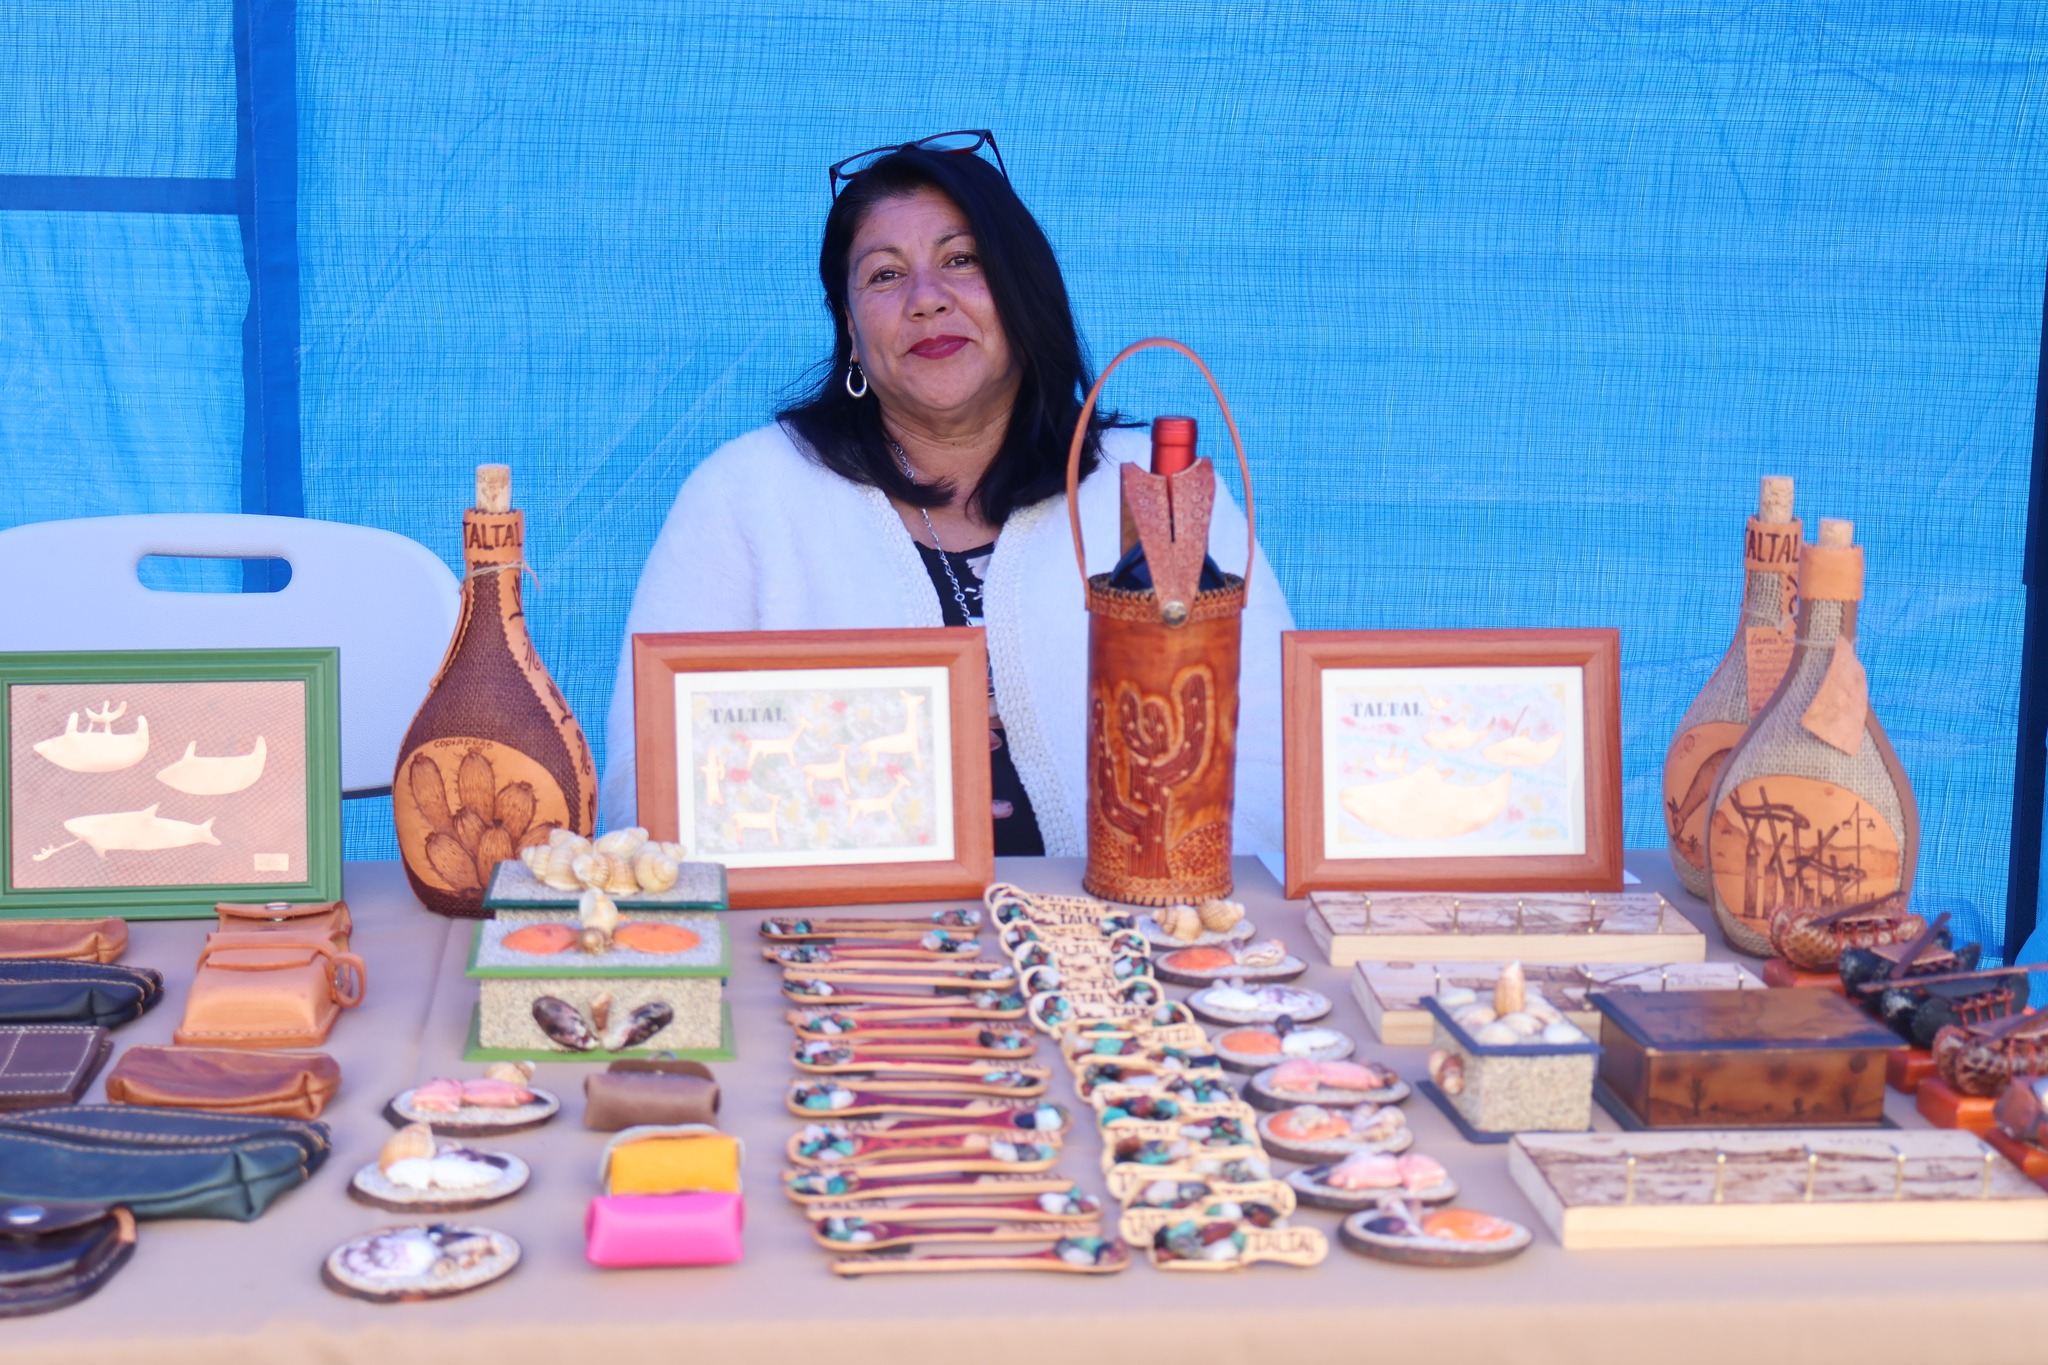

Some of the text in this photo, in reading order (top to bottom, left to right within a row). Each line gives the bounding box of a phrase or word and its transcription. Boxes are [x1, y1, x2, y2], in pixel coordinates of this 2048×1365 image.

[463, 521, 522, 550] TALTAL
[709, 707, 786, 723] TALTAL
[1350, 702, 1423, 717] TALTAL
